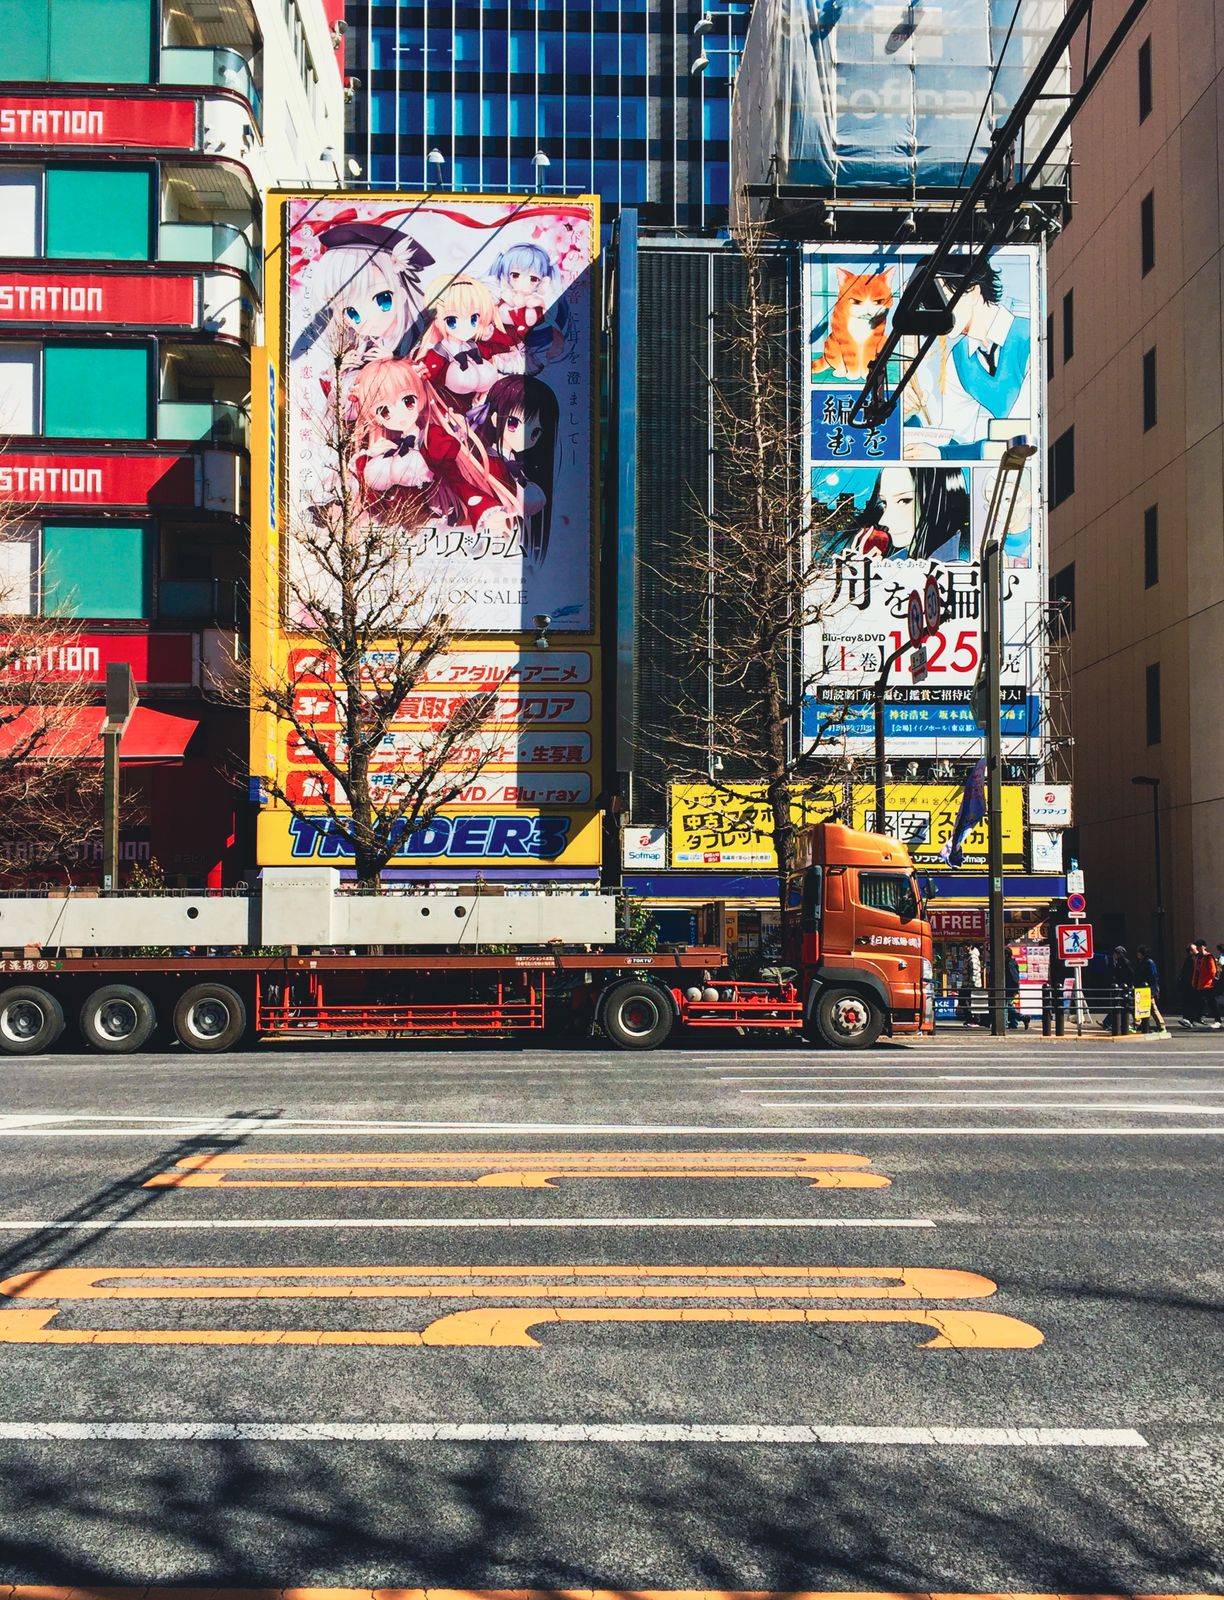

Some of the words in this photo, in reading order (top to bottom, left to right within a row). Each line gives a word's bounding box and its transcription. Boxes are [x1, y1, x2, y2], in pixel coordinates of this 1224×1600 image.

[0, 110, 103, 134] STATION
[0, 287, 102, 312] STATION
[0, 468, 102, 493] STATION
[483, 589, 528, 604] SALE
[296, 696, 330, 715] 3F
[628, 851, 661, 861] Sofmap
[941, 915, 982, 929] FREE
